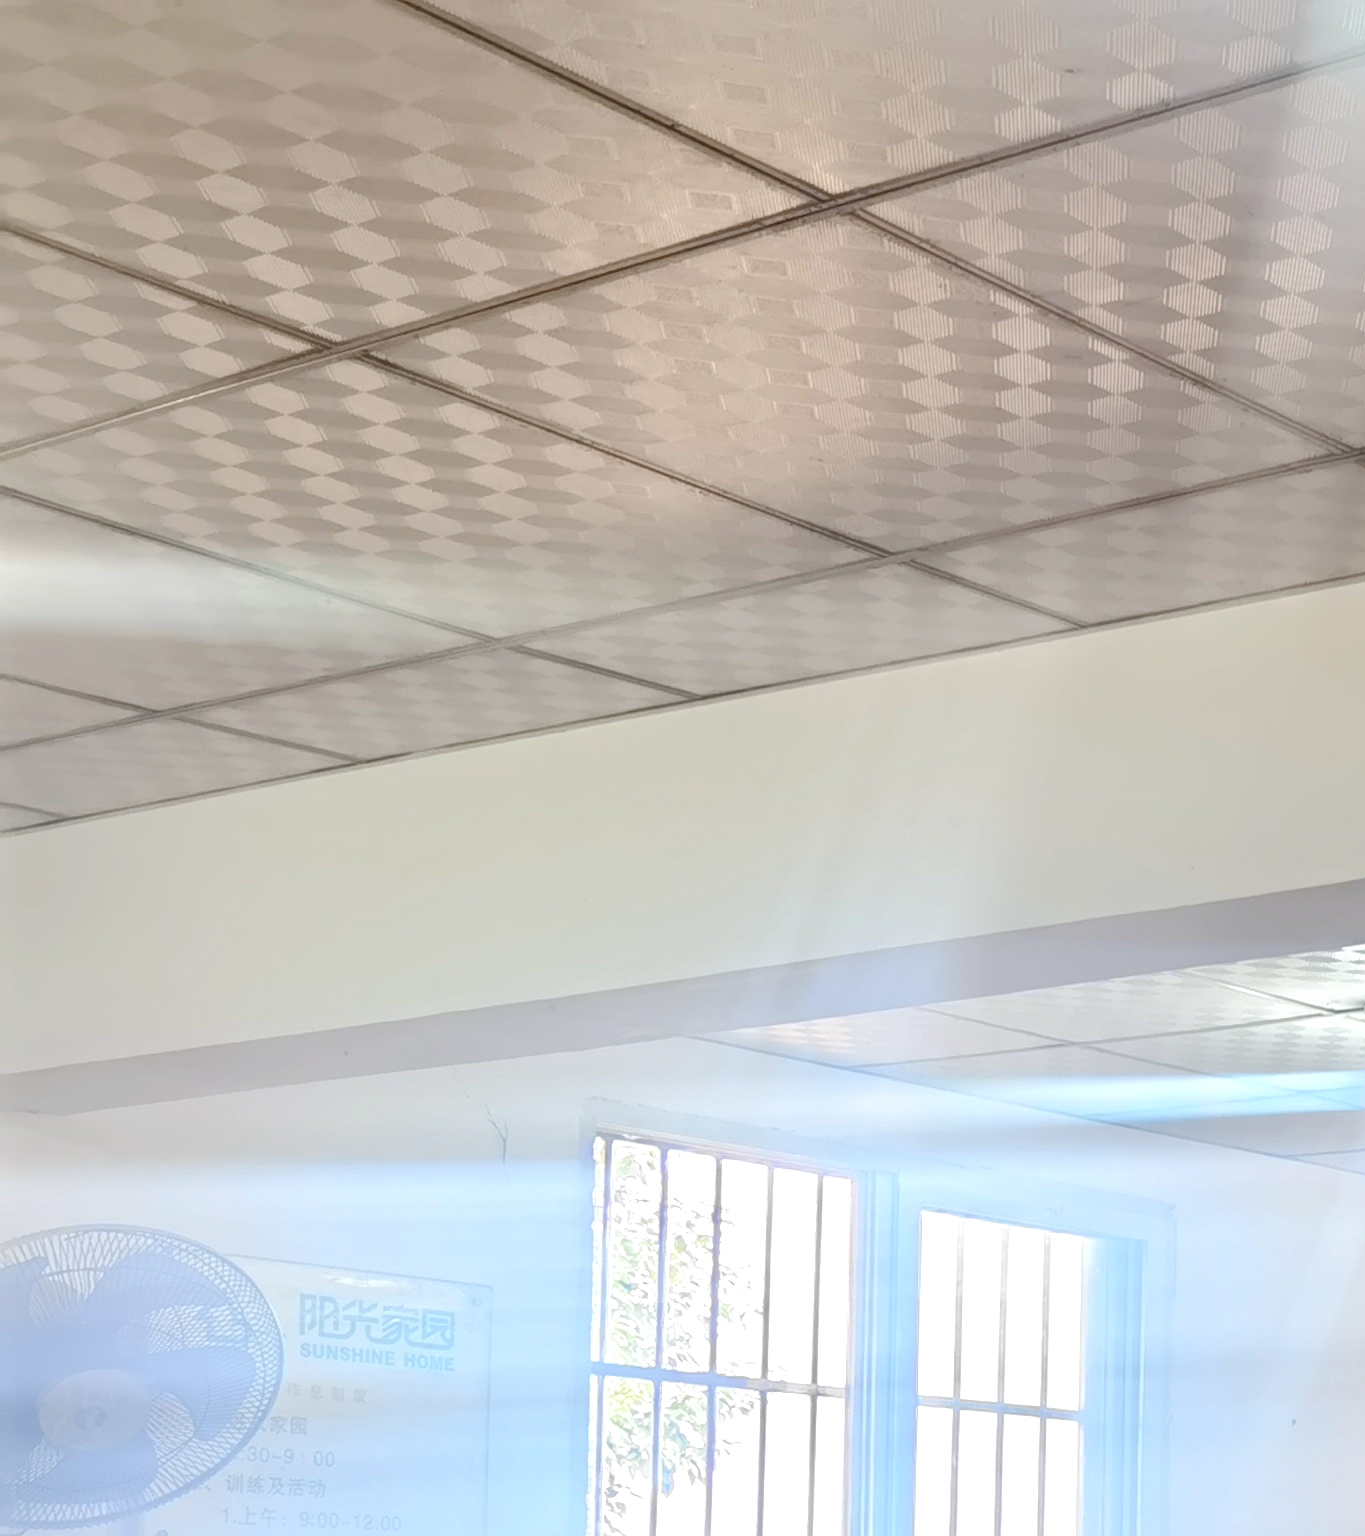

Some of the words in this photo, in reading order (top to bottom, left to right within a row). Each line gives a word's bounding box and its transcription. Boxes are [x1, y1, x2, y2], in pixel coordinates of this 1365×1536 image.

[299, 1293, 455, 1351] 阳光家园
[299, 1342, 395, 1366] SUNSHINE
[403, 1351, 455, 1372] HOME
